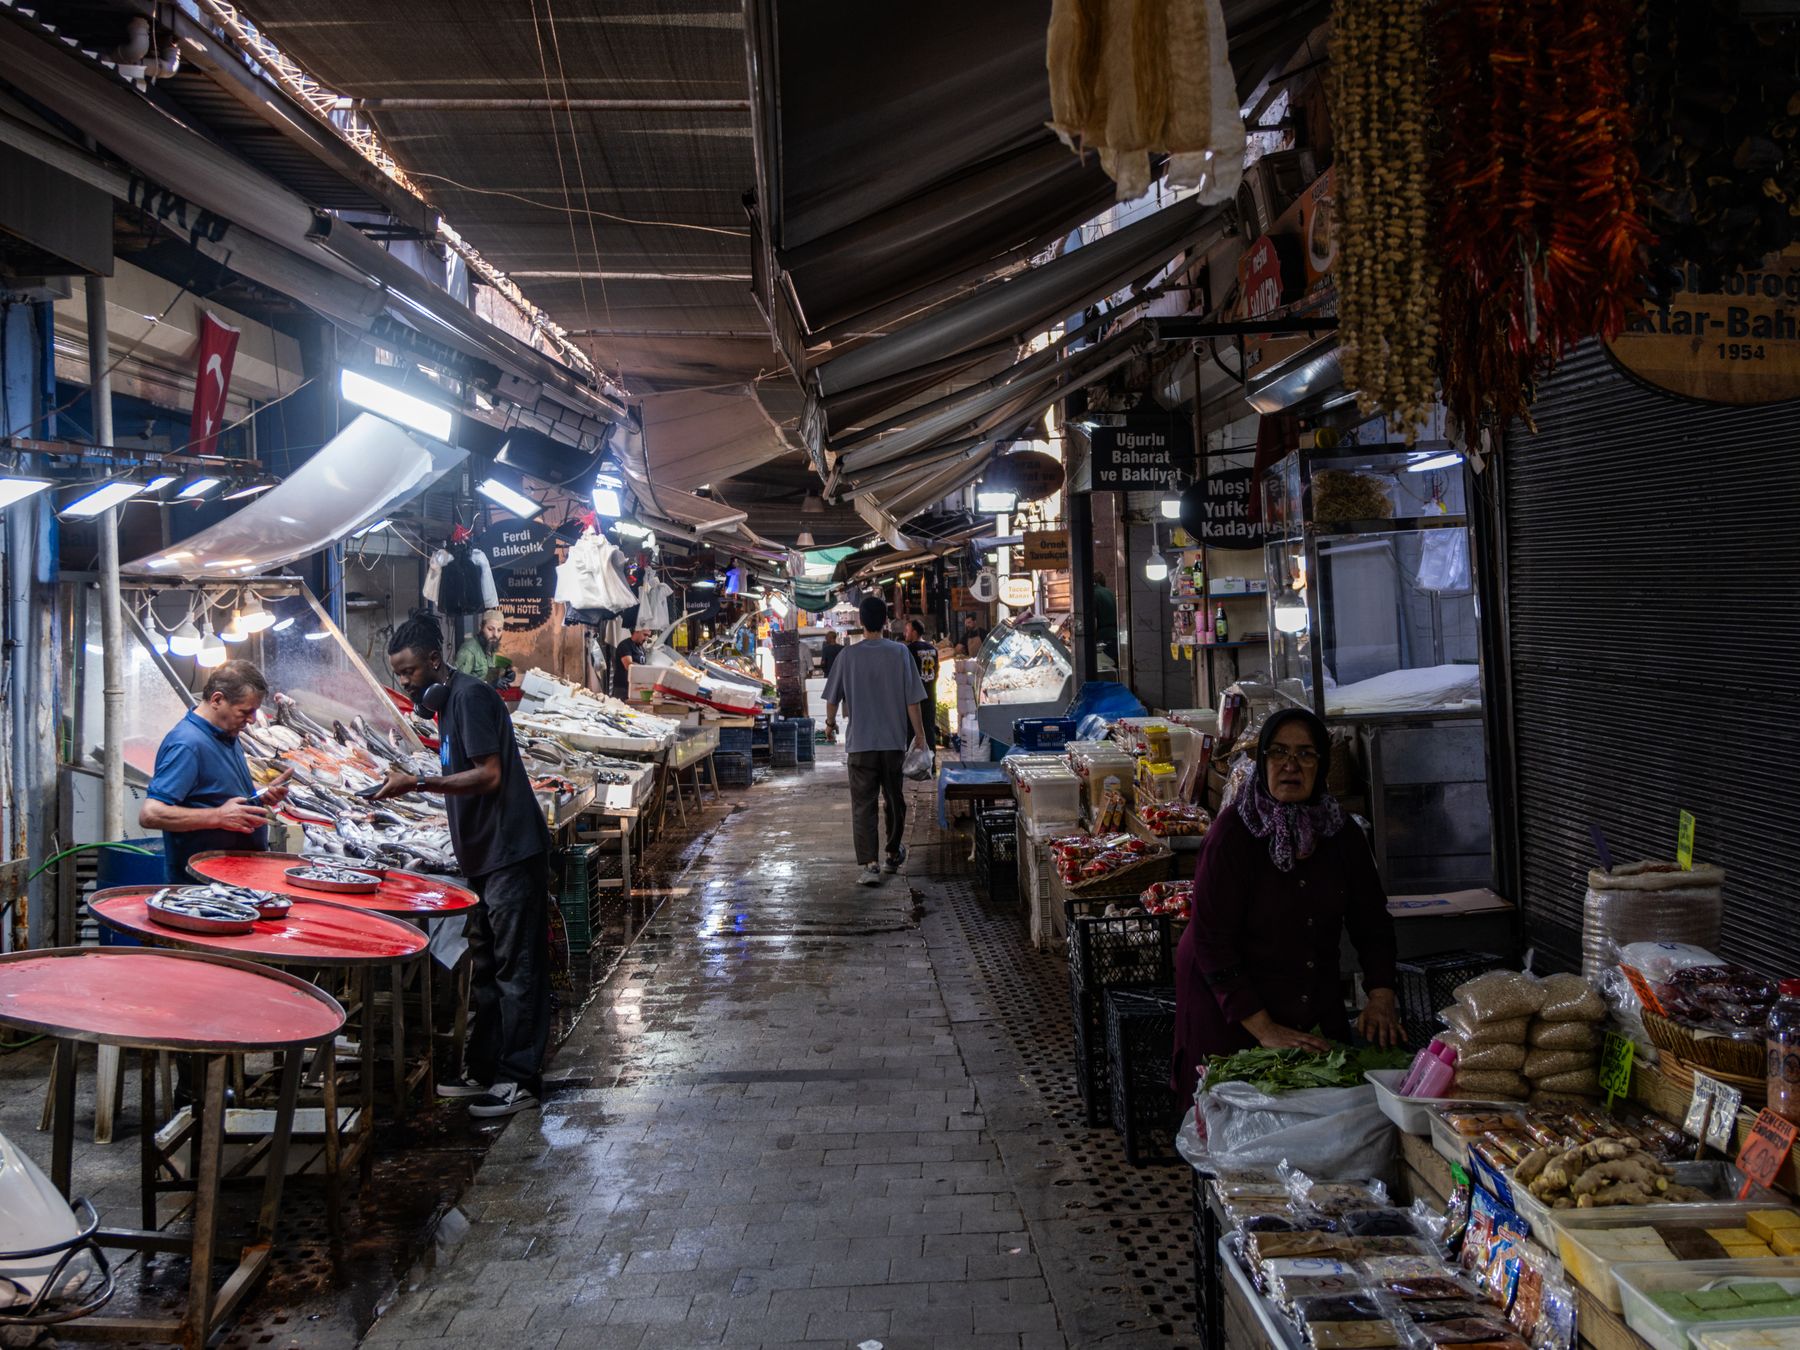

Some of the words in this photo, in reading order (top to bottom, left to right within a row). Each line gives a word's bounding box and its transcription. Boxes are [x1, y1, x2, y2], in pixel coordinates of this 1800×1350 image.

[1718, 343, 1766, 360] 1954
[1116, 432, 1165, 448] Uğurlu
[1111, 449, 1171, 464] Baharat
[1100, 470, 1118, 482] ve
[1121, 467, 1182, 484] Bakliyat
[502, 529, 531, 543] Ferdi
[1201, 521, 1264, 539] Kadayı
[492, 541, 544, 558] Balıkçılık
[508, 577, 534, 587] Balık
[536, 576, 543, 586] 2
[516, 604, 541, 615] HOTEL
